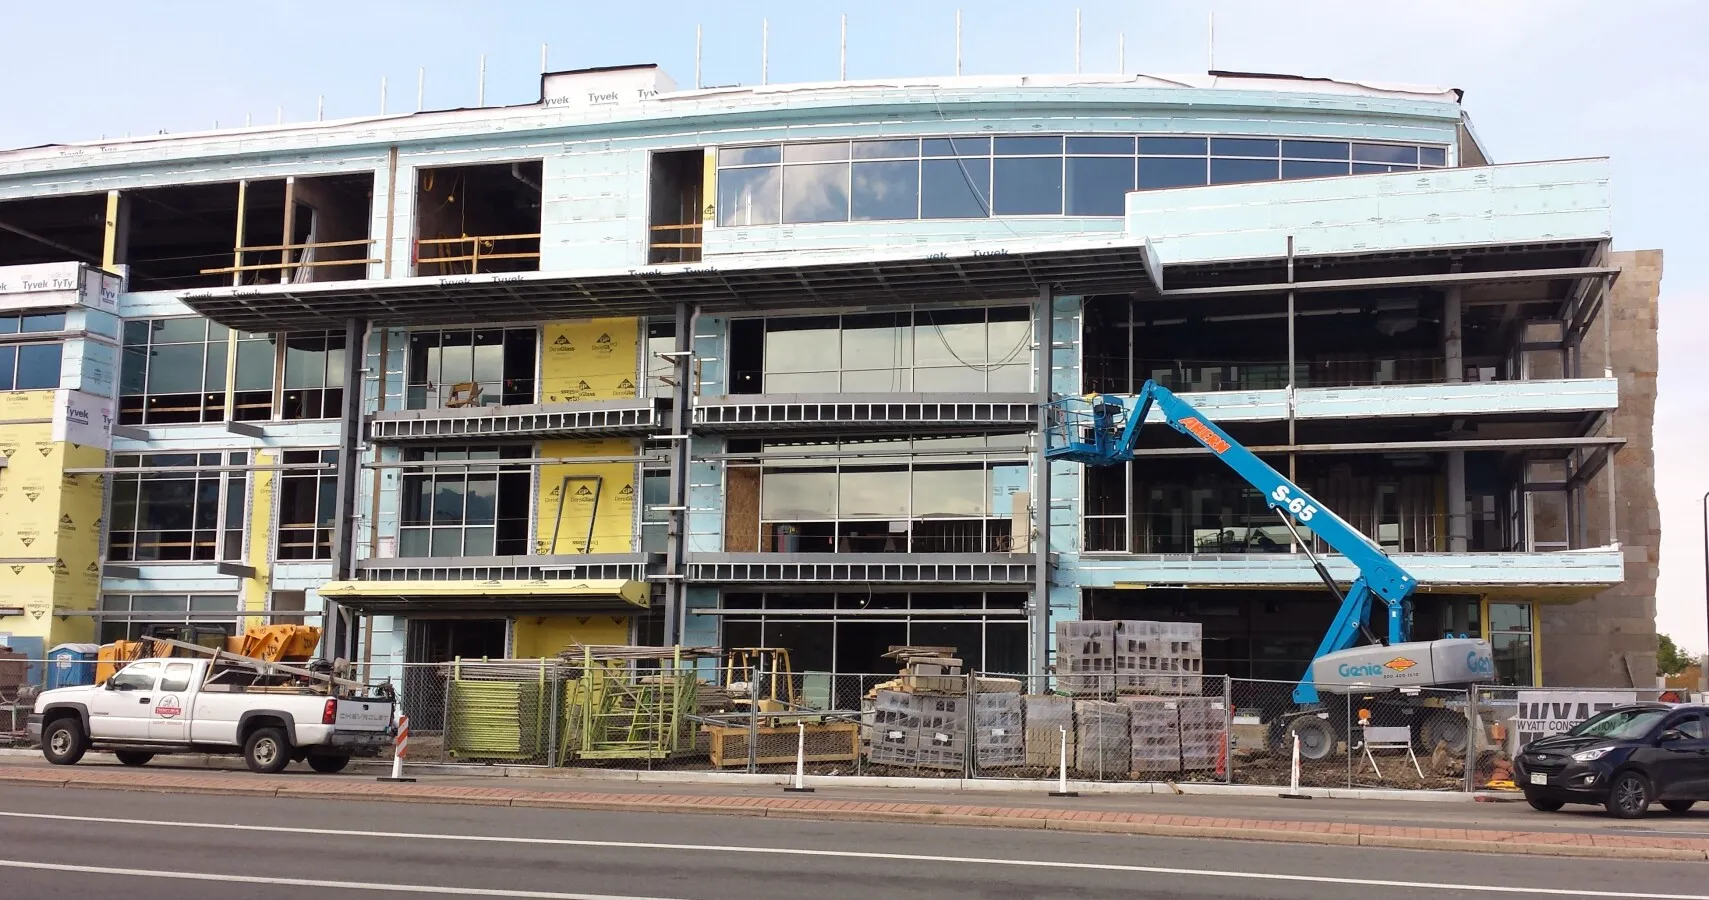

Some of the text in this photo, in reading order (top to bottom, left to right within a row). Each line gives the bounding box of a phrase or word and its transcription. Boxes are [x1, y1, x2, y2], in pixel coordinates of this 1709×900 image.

[588, 92, 618, 103] Tyvek
[22, 279, 48, 291] Tyvek
[66, 405, 89, 419] Tyvek
[1178, 416, 1231, 454] AHERN
[1272, 485, 1318, 522] S-65
[1338, 663, 1383, 678] Genie
[1517, 720, 1545, 731] WYATT
